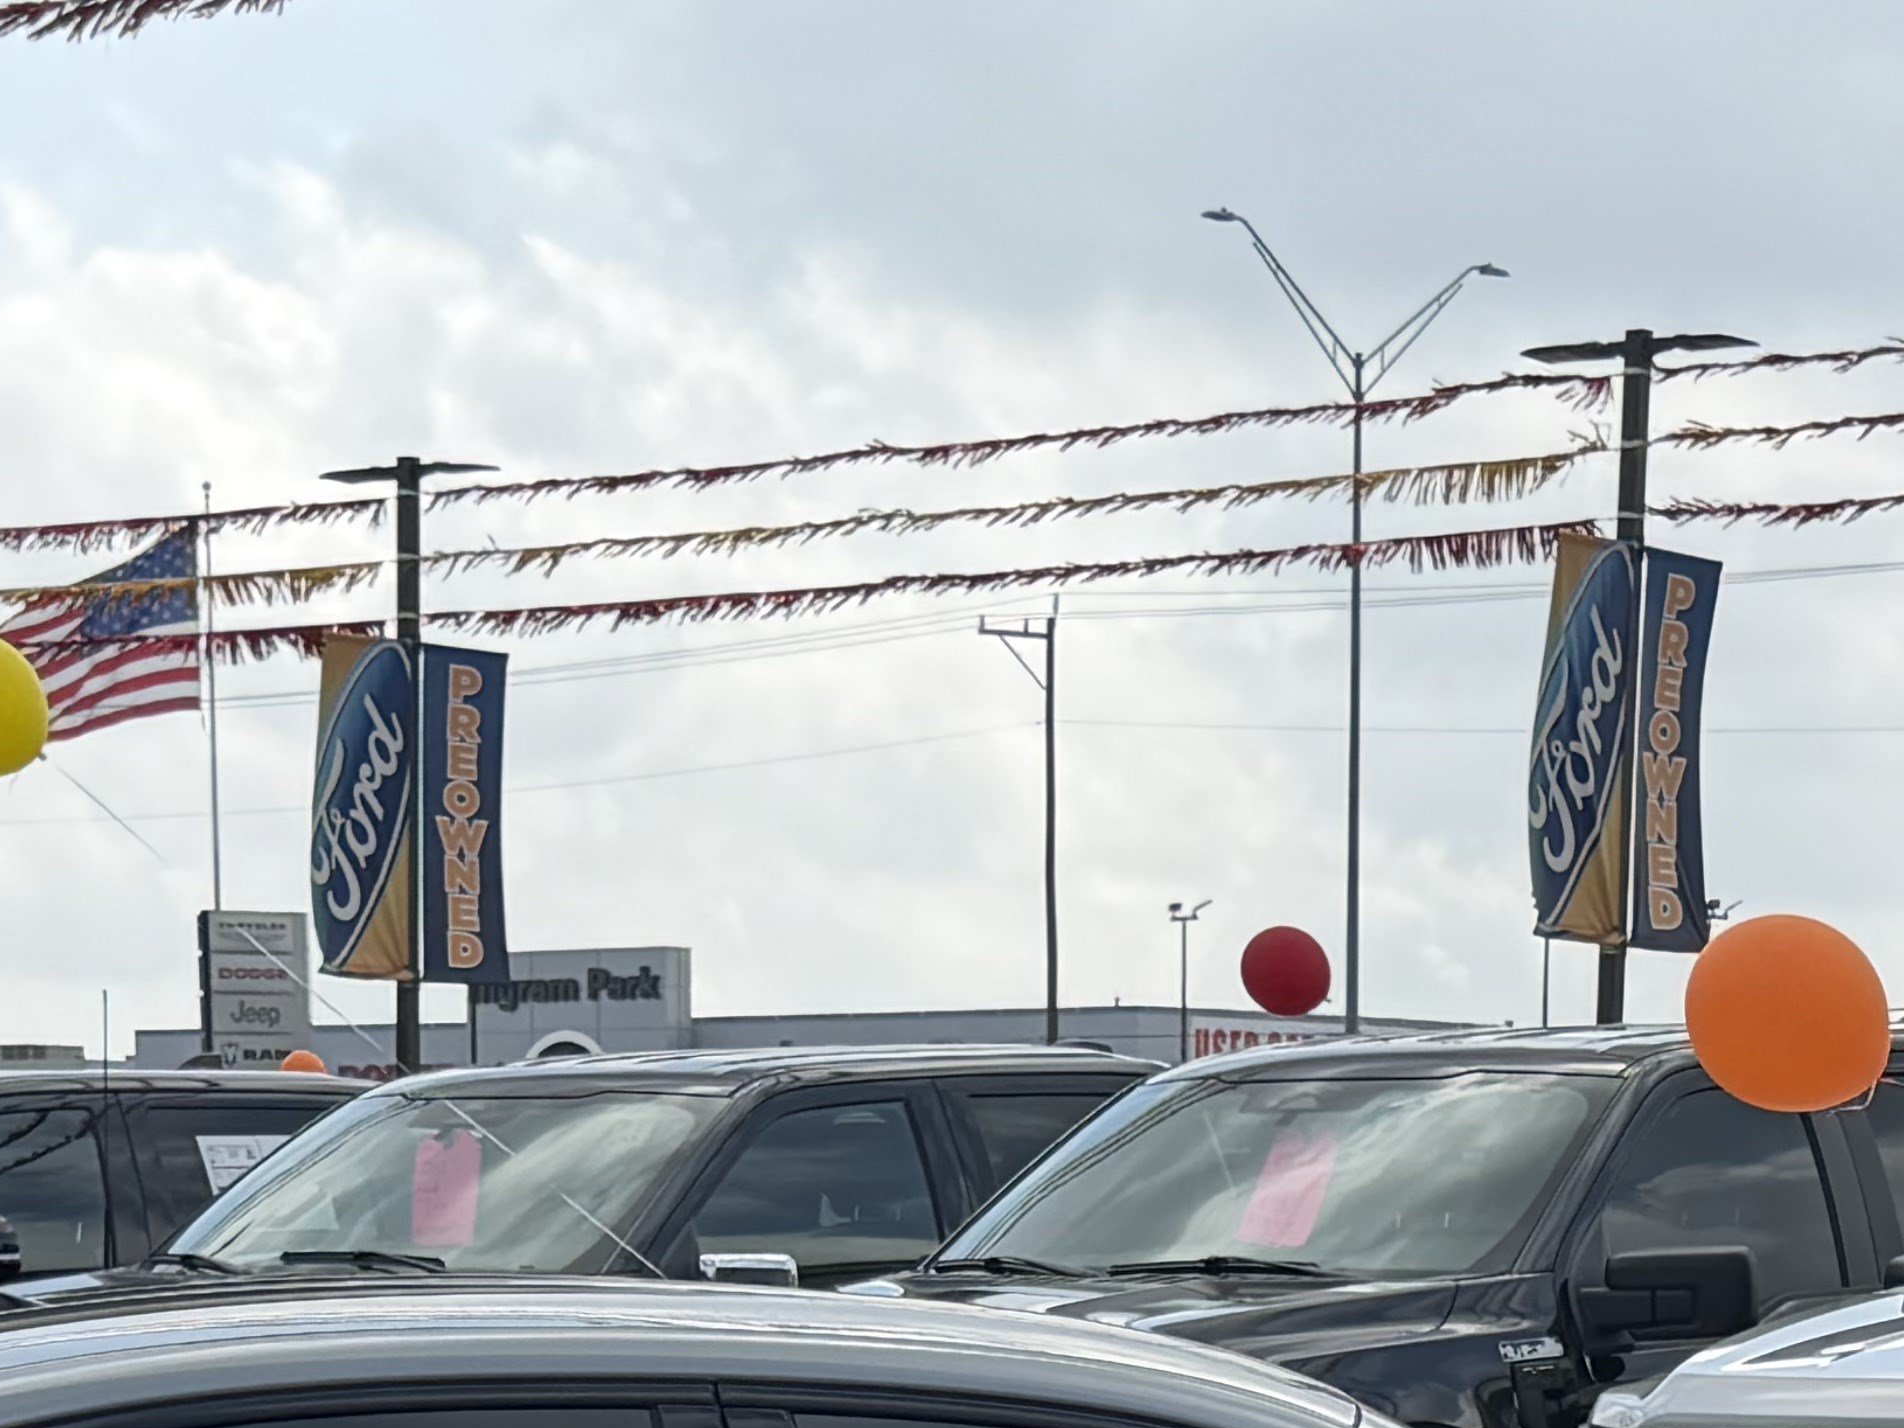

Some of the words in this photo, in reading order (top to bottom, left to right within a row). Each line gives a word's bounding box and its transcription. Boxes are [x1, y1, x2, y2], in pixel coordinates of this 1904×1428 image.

[1529, 604, 1622, 873] Ford
[311, 694, 404, 921] Ford
[230, 1001, 281, 1028] Jeep
[587, 966, 661, 1000] Park
